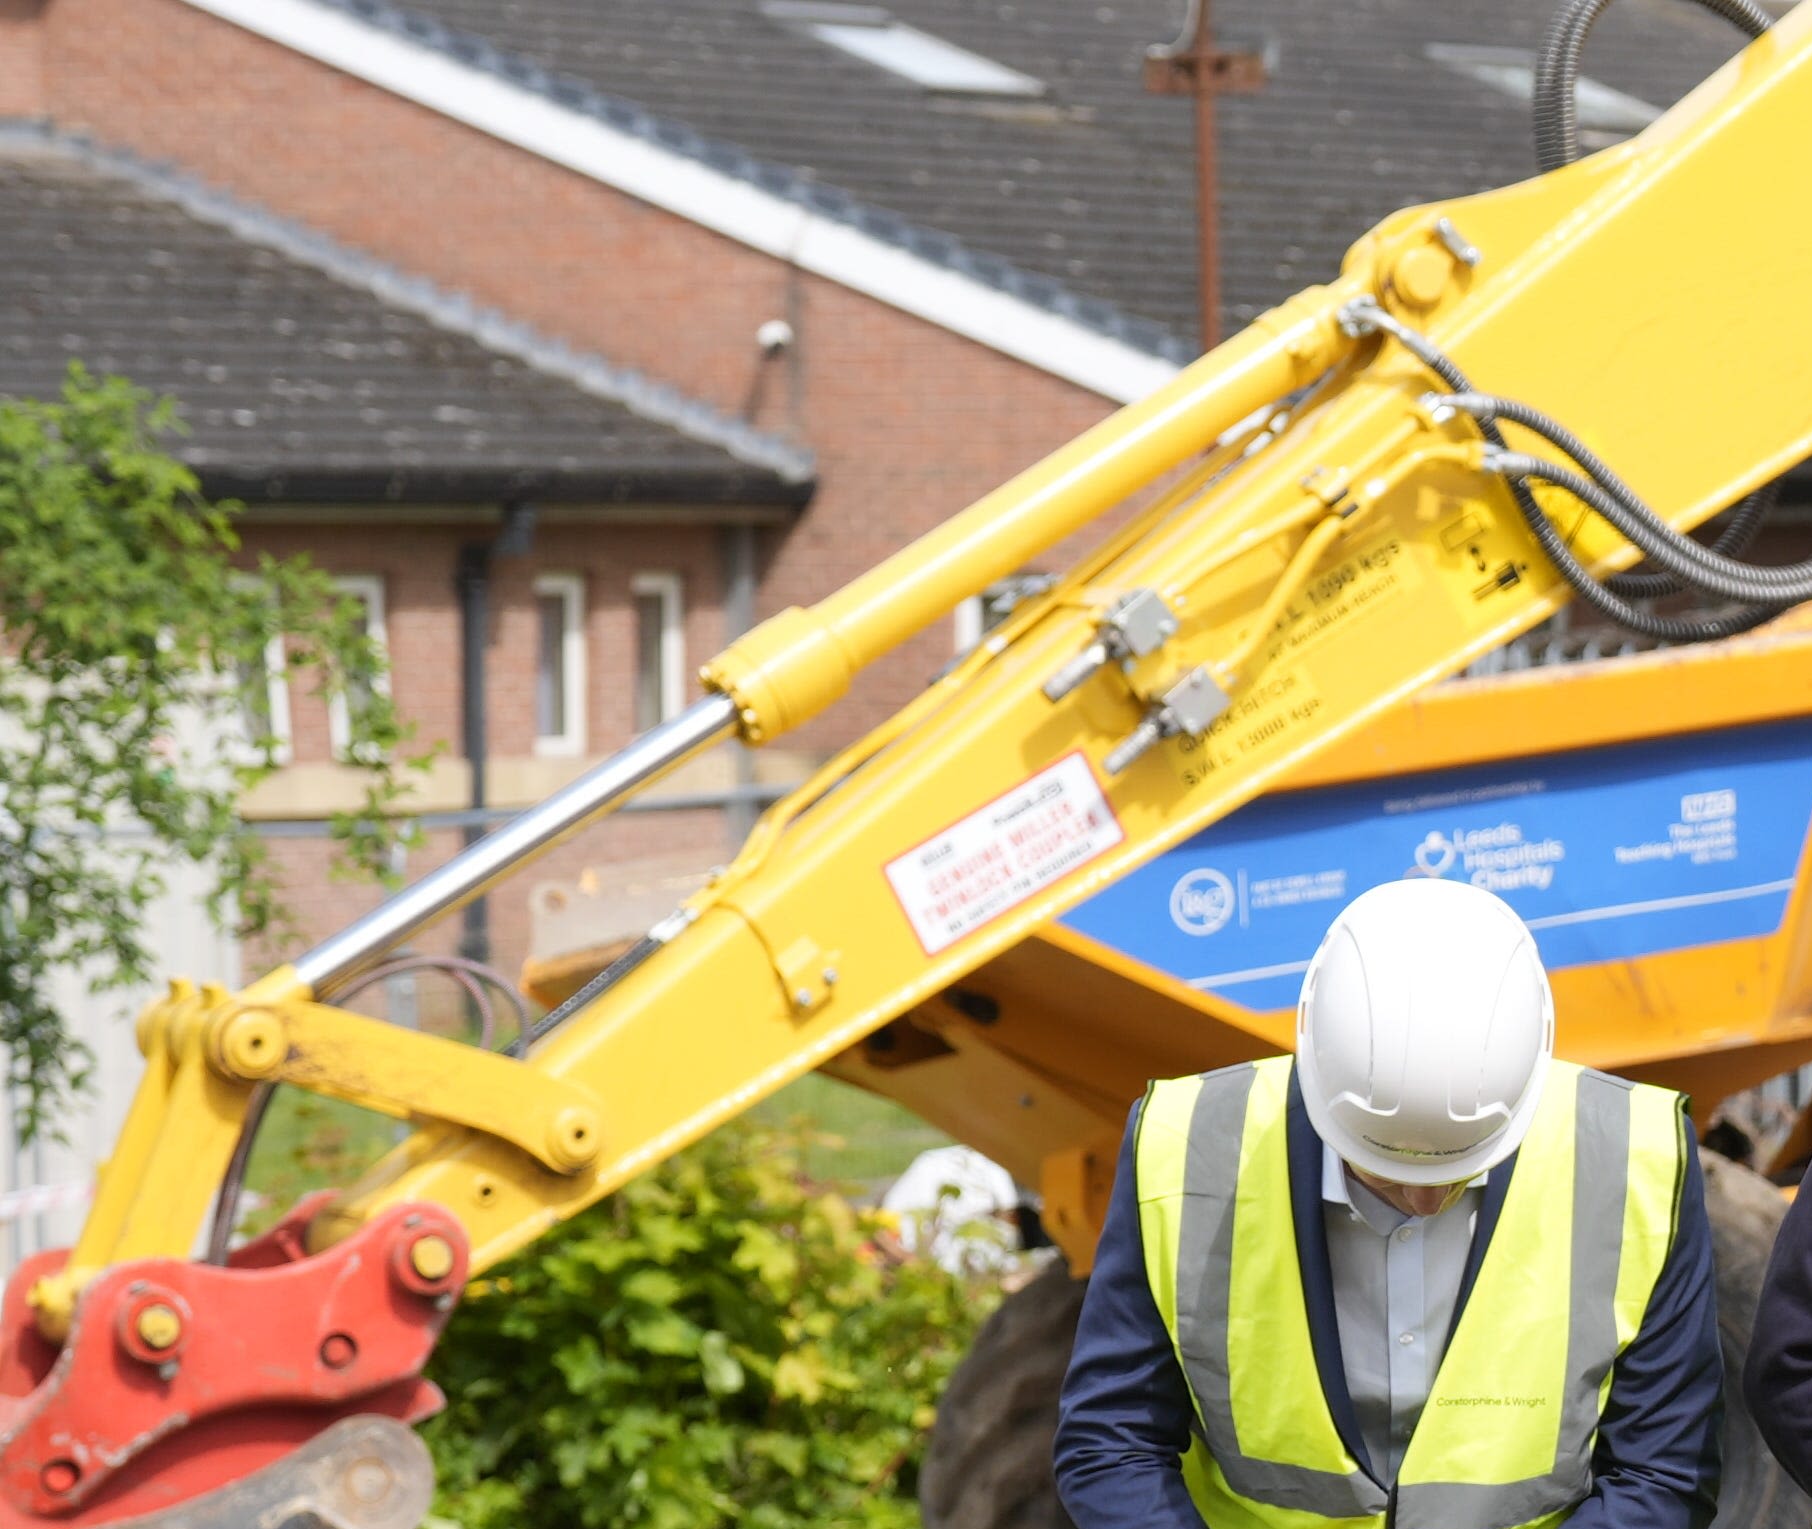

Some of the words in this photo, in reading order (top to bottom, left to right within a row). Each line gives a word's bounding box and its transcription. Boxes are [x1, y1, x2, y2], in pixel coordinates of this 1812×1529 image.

[1454, 823, 1522, 851] Leeds
[1463, 839, 1566, 873] Hospitals
[1470, 864, 1554, 891] Charity
